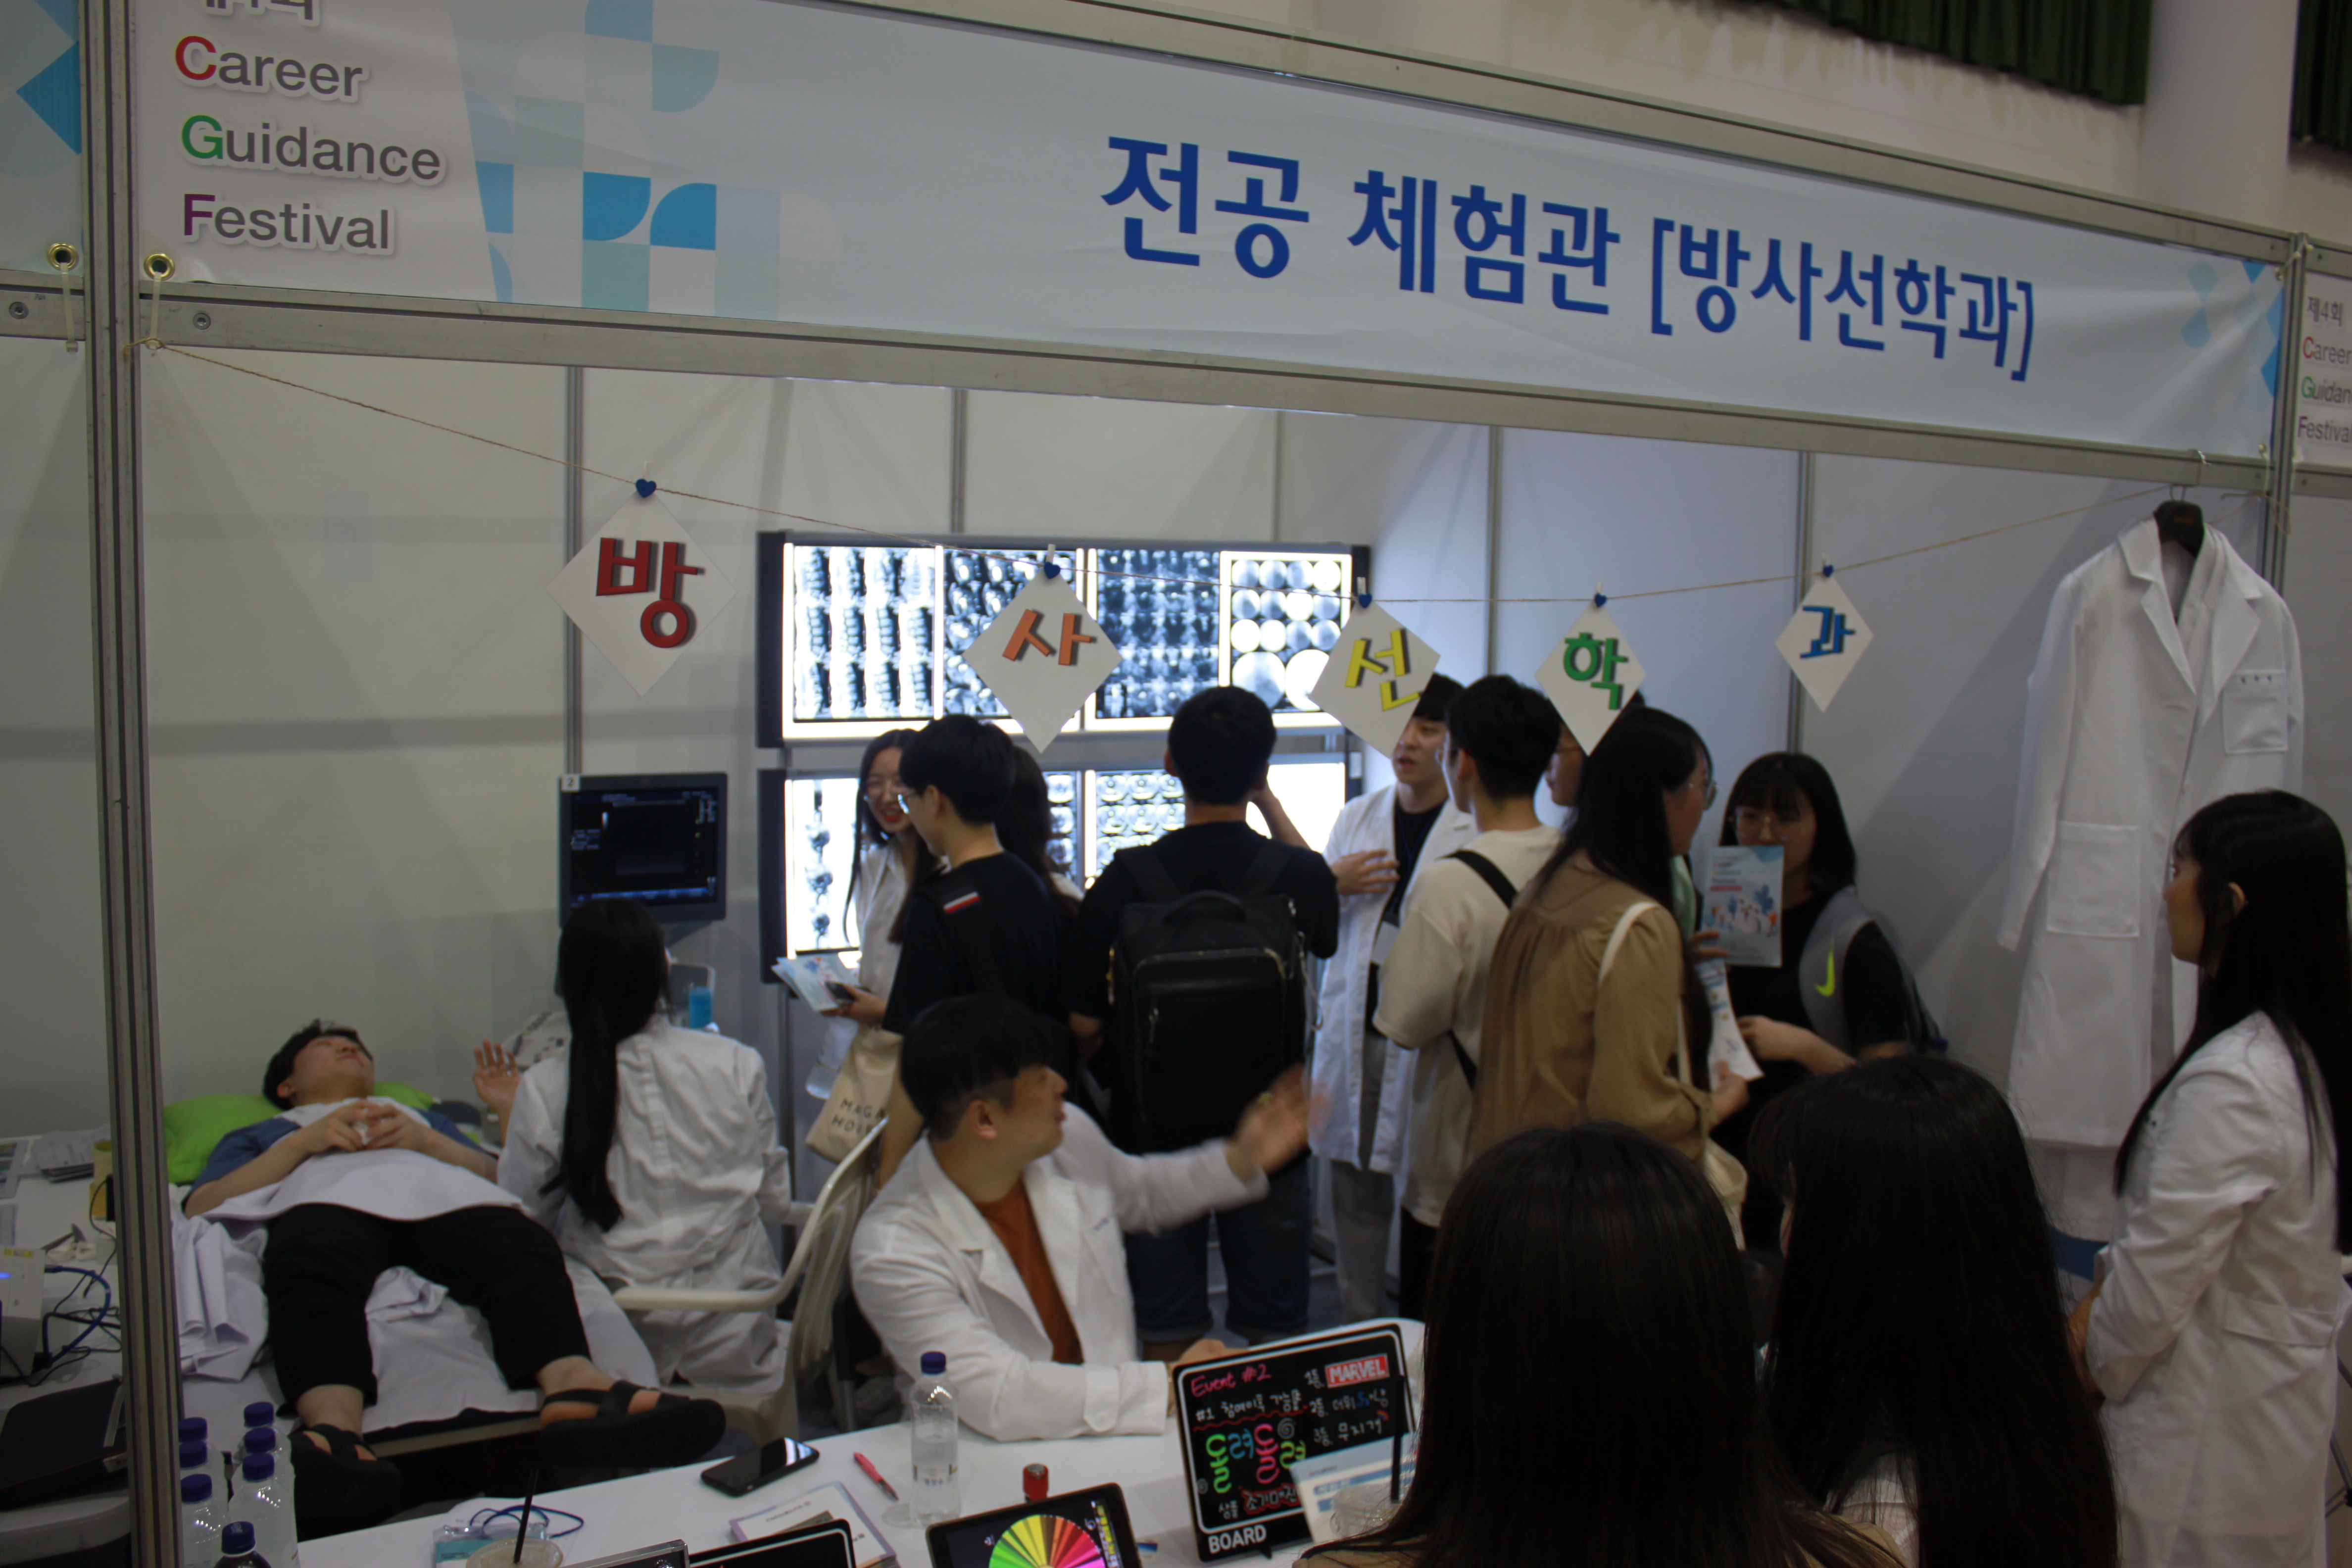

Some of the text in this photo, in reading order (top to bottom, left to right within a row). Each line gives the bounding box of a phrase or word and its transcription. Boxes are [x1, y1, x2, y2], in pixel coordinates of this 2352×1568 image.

[174, 35, 363, 97] Career
[181, 114, 441, 180] Guidance
[183, 193, 389, 249] Festival
[1102, 136, 2034, 381] 전공 체험관 [방사선학과]
[2307, 296, 2343, 327] 제4회
[597, 537, 1855, 712] 방 사 선 학 과
[1190, 1363, 1272, 1398] Event #2
[1329, 1358, 1386, 1384] MARVEL
[1195, 1407, 1216, 1422] #1
[1208, 1523, 1267, 1555] BOARD
